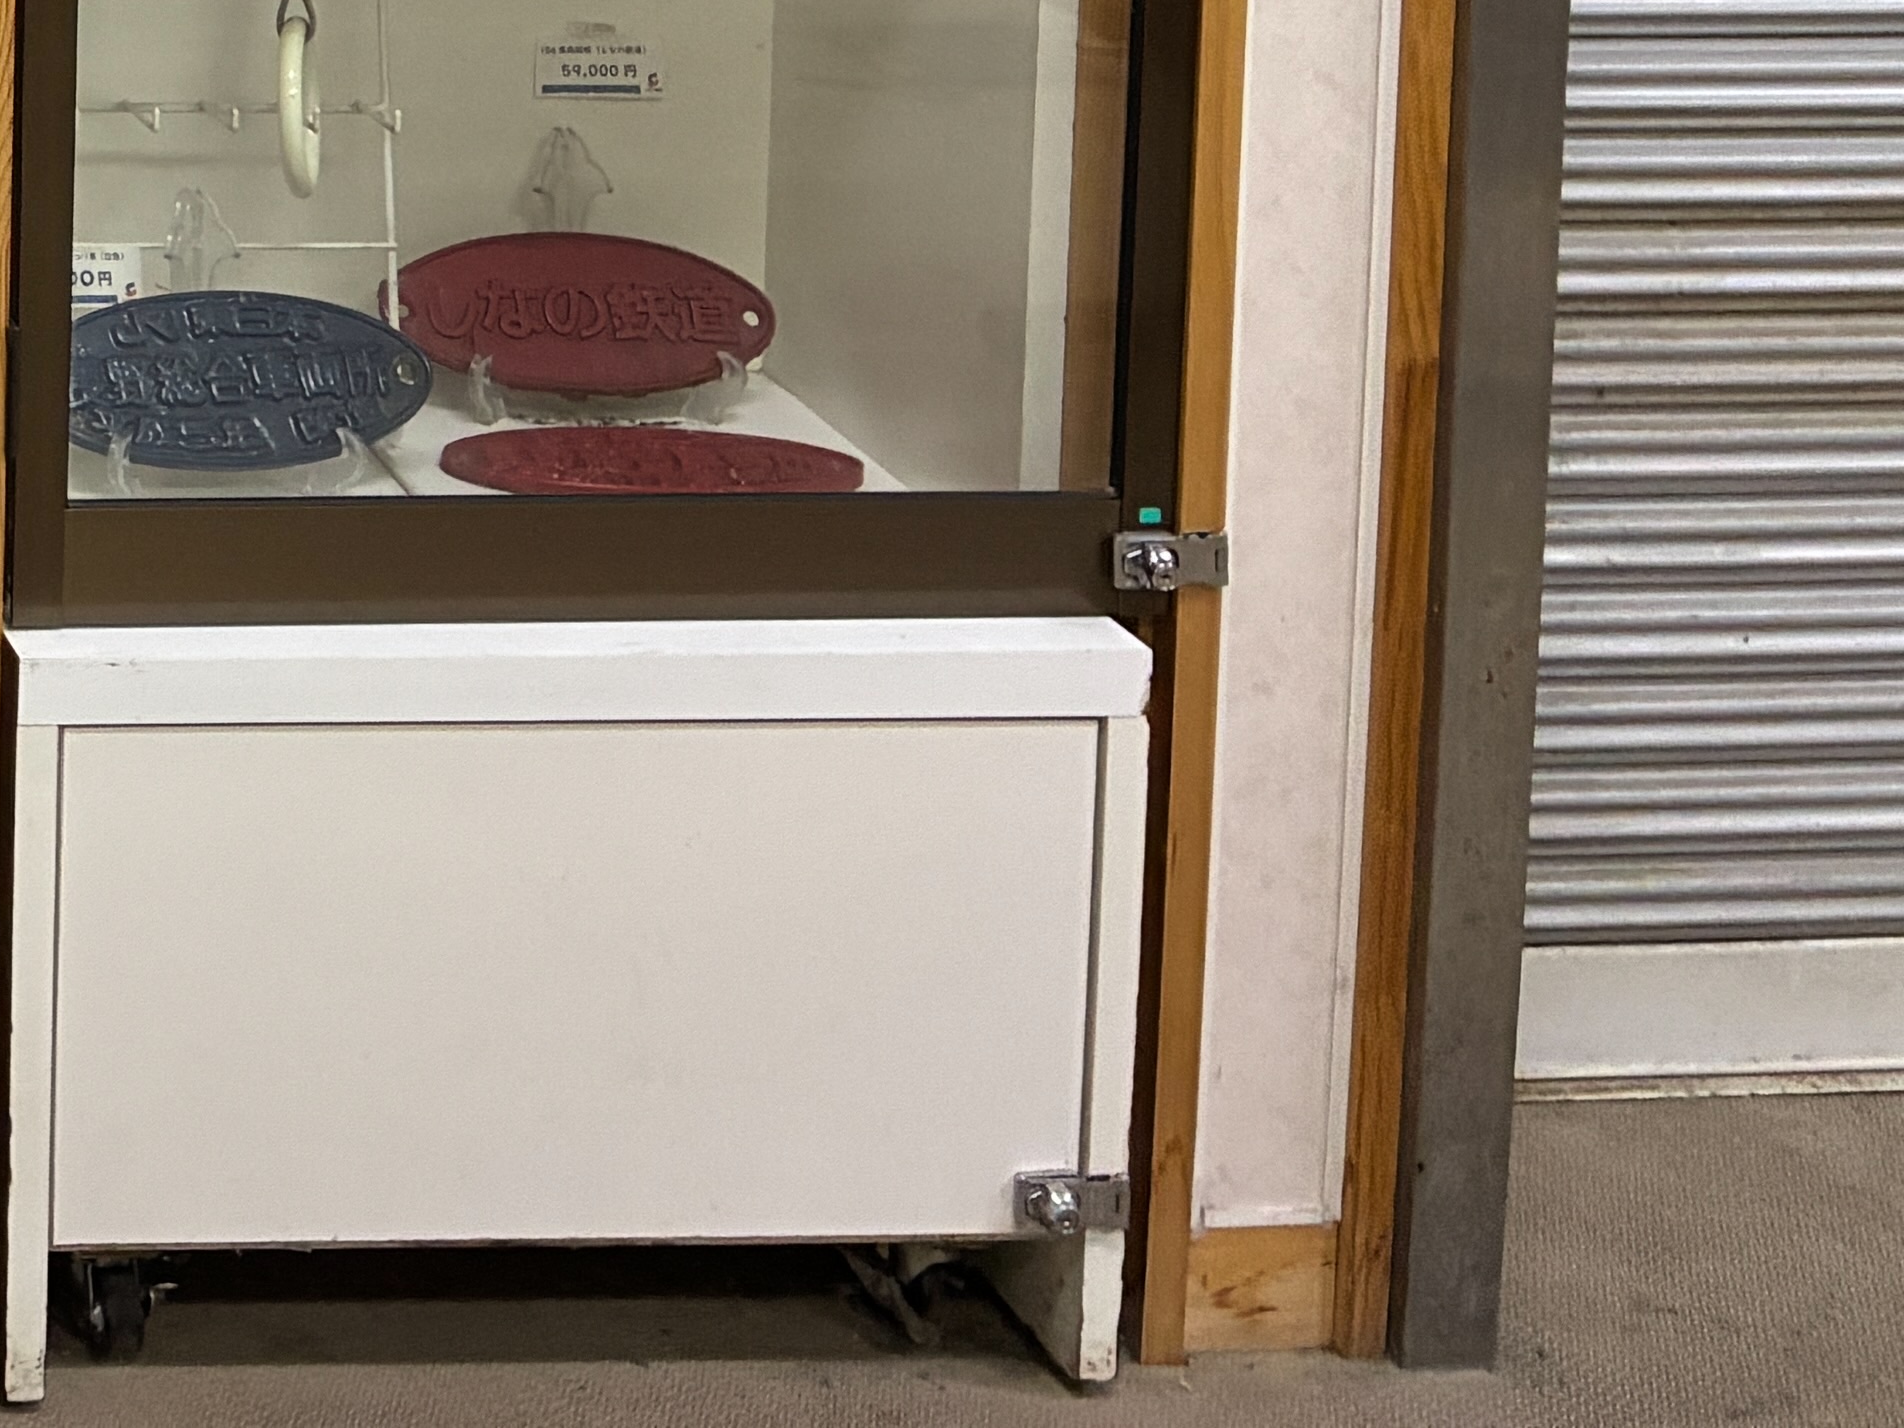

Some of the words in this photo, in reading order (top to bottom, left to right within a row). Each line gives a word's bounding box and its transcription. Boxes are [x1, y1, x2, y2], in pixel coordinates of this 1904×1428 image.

[624, 64, 636, 78] 円
[428, 282, 739, 342] しなの鉄道
